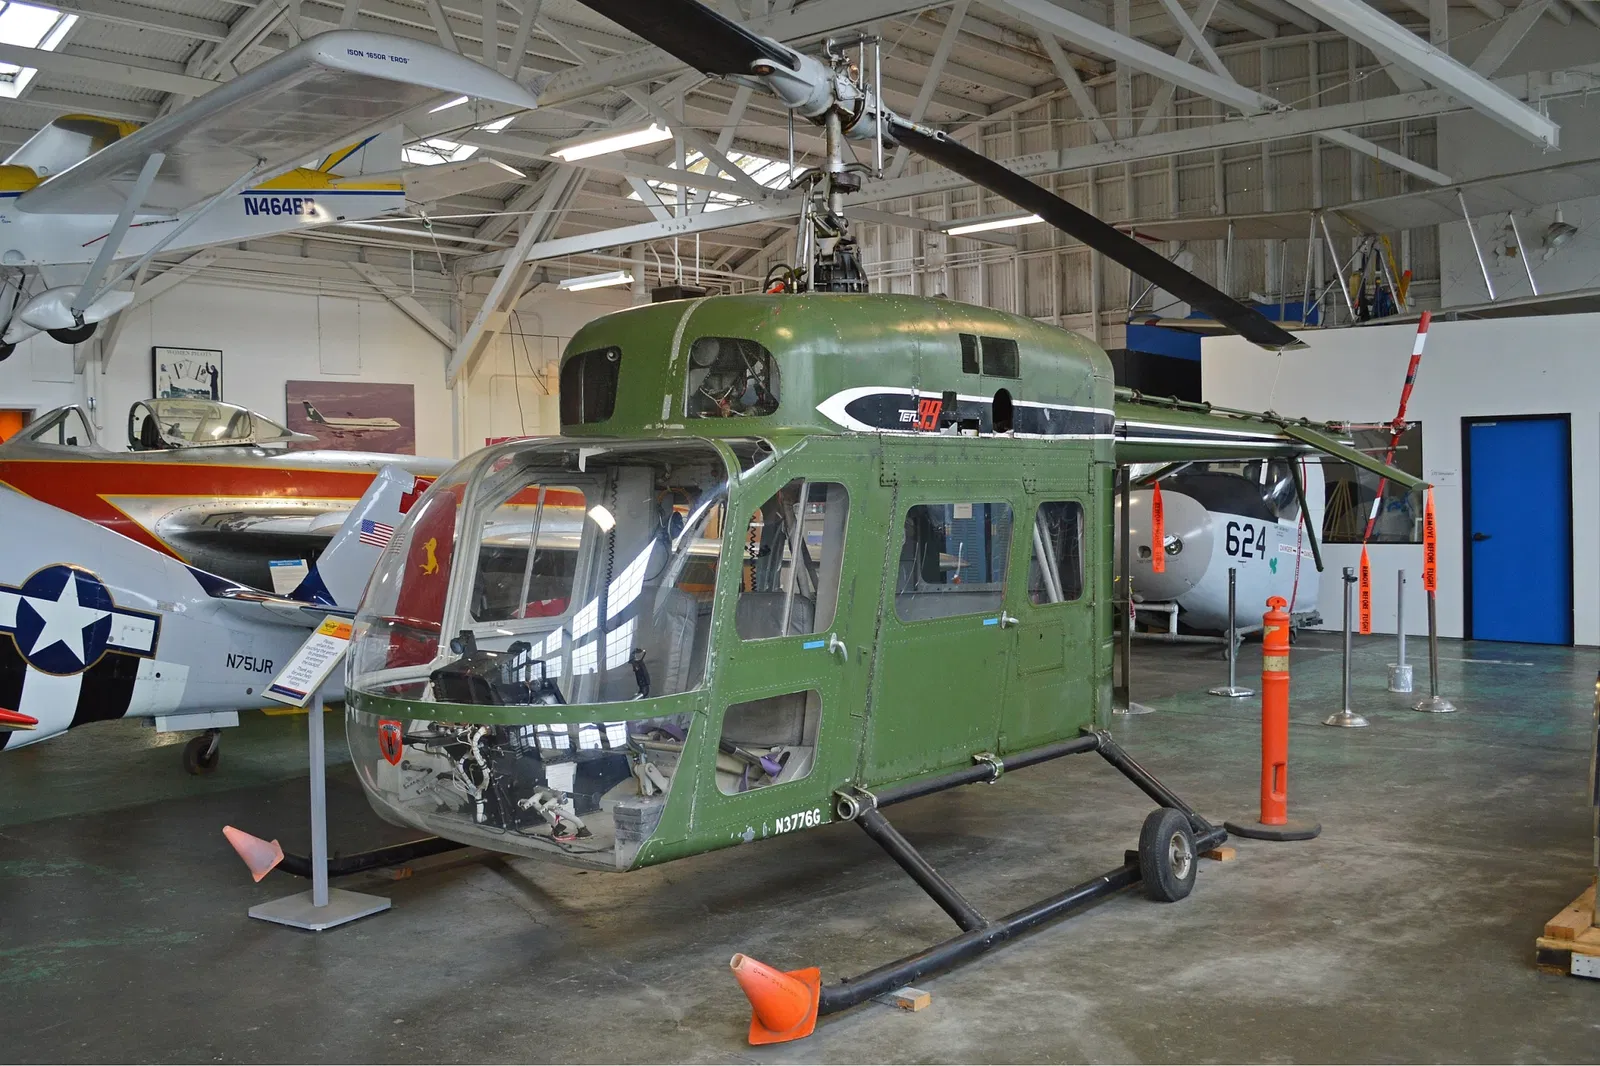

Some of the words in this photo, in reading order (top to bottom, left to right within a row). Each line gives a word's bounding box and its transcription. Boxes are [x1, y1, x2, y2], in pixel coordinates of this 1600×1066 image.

[347, 48, 364, 57] ISON
[366, 52, 387, 61] 1650R
[1226, 521, 1266, 560] 624
[1427, 542, 1435, 564] BEFORE
[226, 653, 273, 674] N751JR
[775, 808, 820, 835] N3776G
